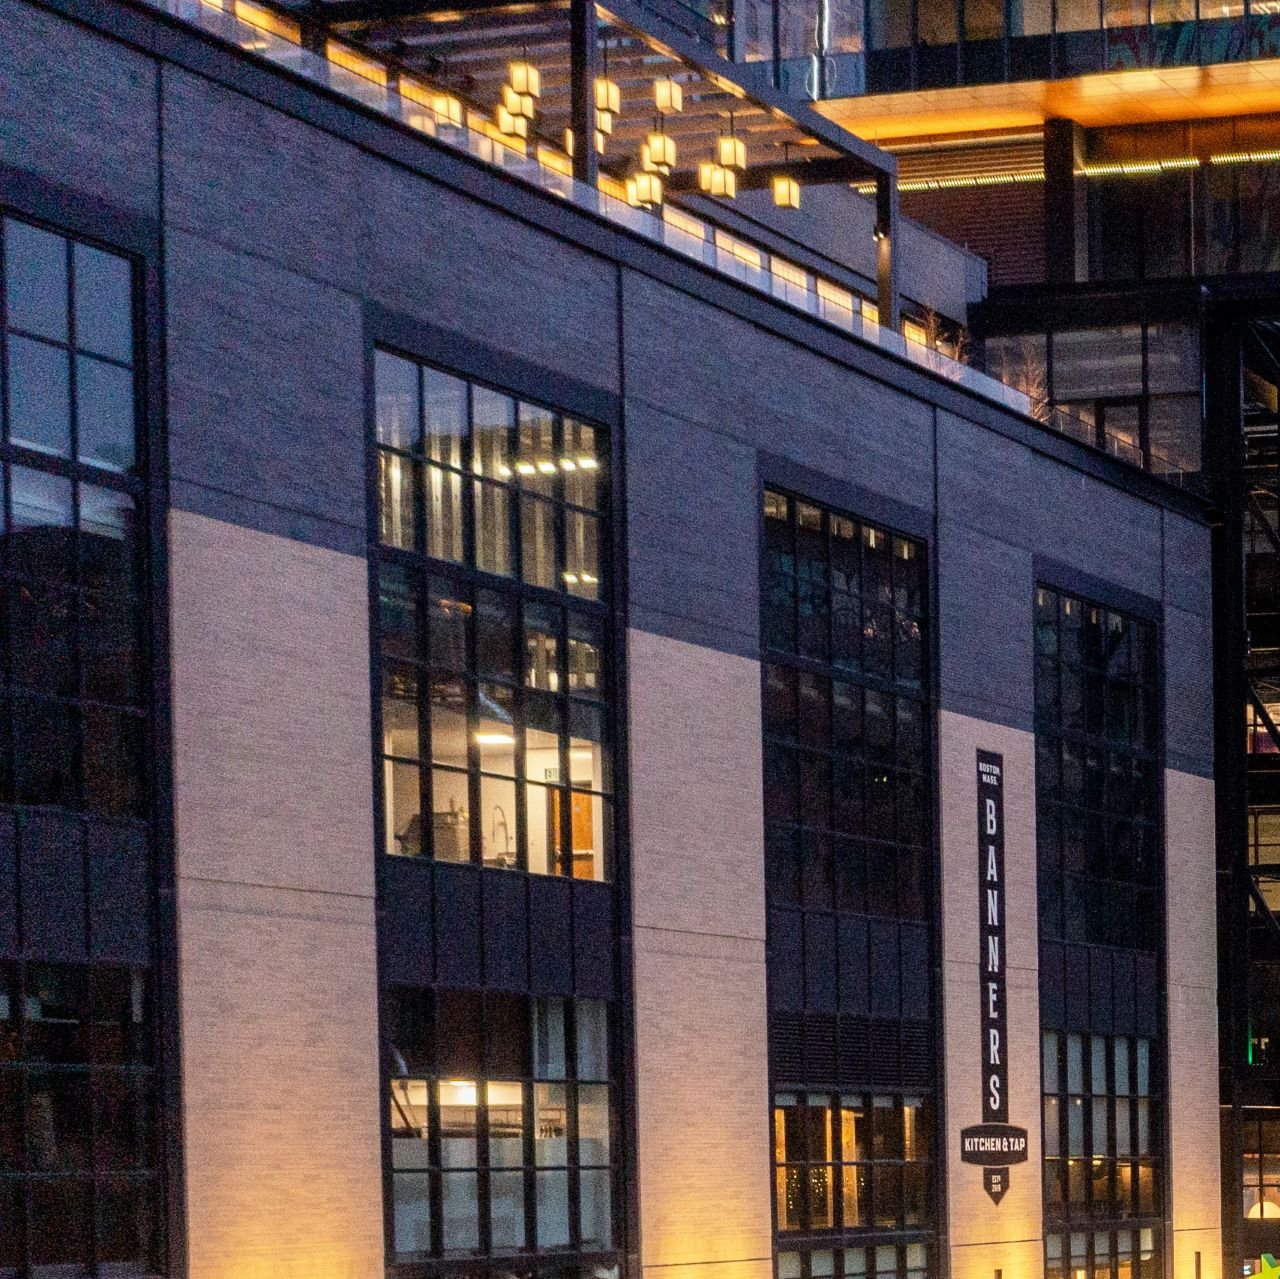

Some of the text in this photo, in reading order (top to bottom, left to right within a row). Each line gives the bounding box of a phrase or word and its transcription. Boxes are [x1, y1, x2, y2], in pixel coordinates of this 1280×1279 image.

[985, 799, 1000, 1110] BANNERS
[965, 1137, 1025, 1152] KITCHEN & TAP
